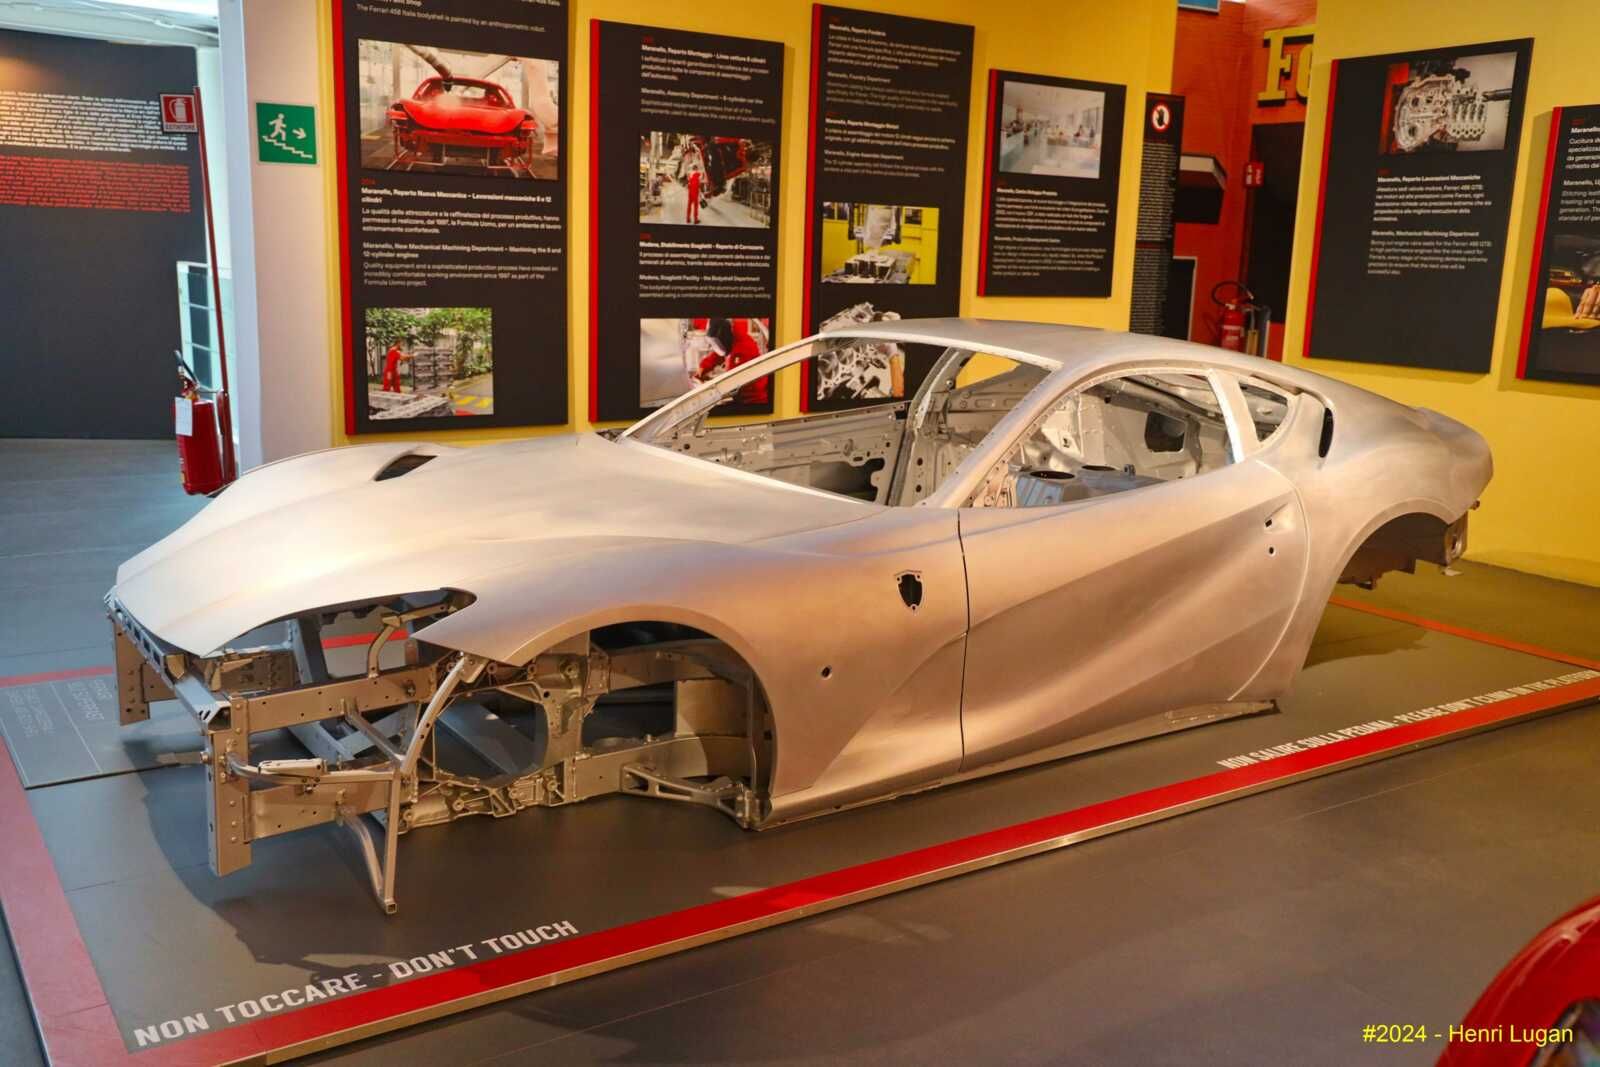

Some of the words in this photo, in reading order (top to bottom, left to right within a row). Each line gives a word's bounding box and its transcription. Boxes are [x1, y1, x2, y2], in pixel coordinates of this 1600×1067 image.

[1216, 753, 1252, 769] NON
[1249, 741, 1308, 763] SALIRE
[1297, 732, 1345, 749] SULLA
[1337, 719, 1395, 740] PEDANA
[1395, 706, 1448, 724] PLEASE
[133, 1012, 209, 1049] NON
[215, 971, 368, 1025] TOCCARE
[388, 943, 477, 981] DON'T
[481, 919, 580, 955] TOUCH
